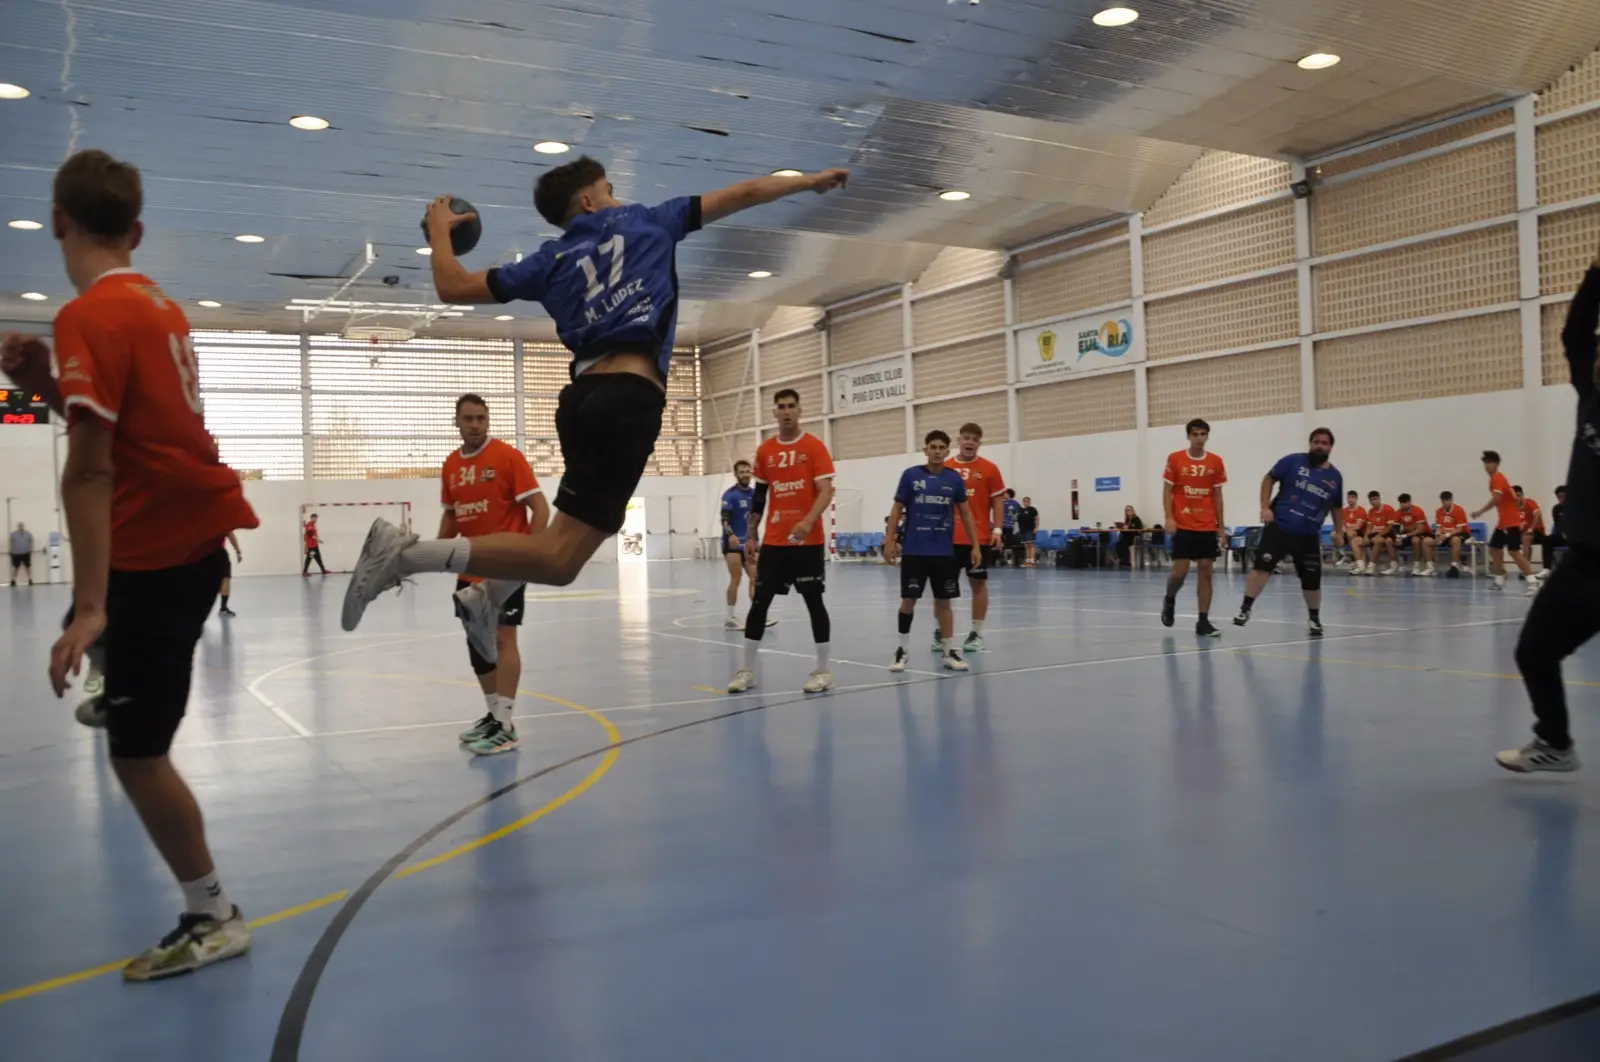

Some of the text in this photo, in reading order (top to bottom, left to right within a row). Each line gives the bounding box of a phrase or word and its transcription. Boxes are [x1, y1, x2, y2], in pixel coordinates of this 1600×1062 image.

[575, 234, 625, 302] 17
[584, 306, 602, 324] M.
[604, 278, 645, 312] LOPEZ
[1078, 329, 1099, 340] SANTA
[852, 367, 903, 387] HANDBOL CLUB
[852, 391, 868, 404] PUIG
[778, 450, 796, 468] 21
[458, 464, 477, 486] 34
[1190, 464, 1206, 477] 37
[913, 480, 926, 491] 24
